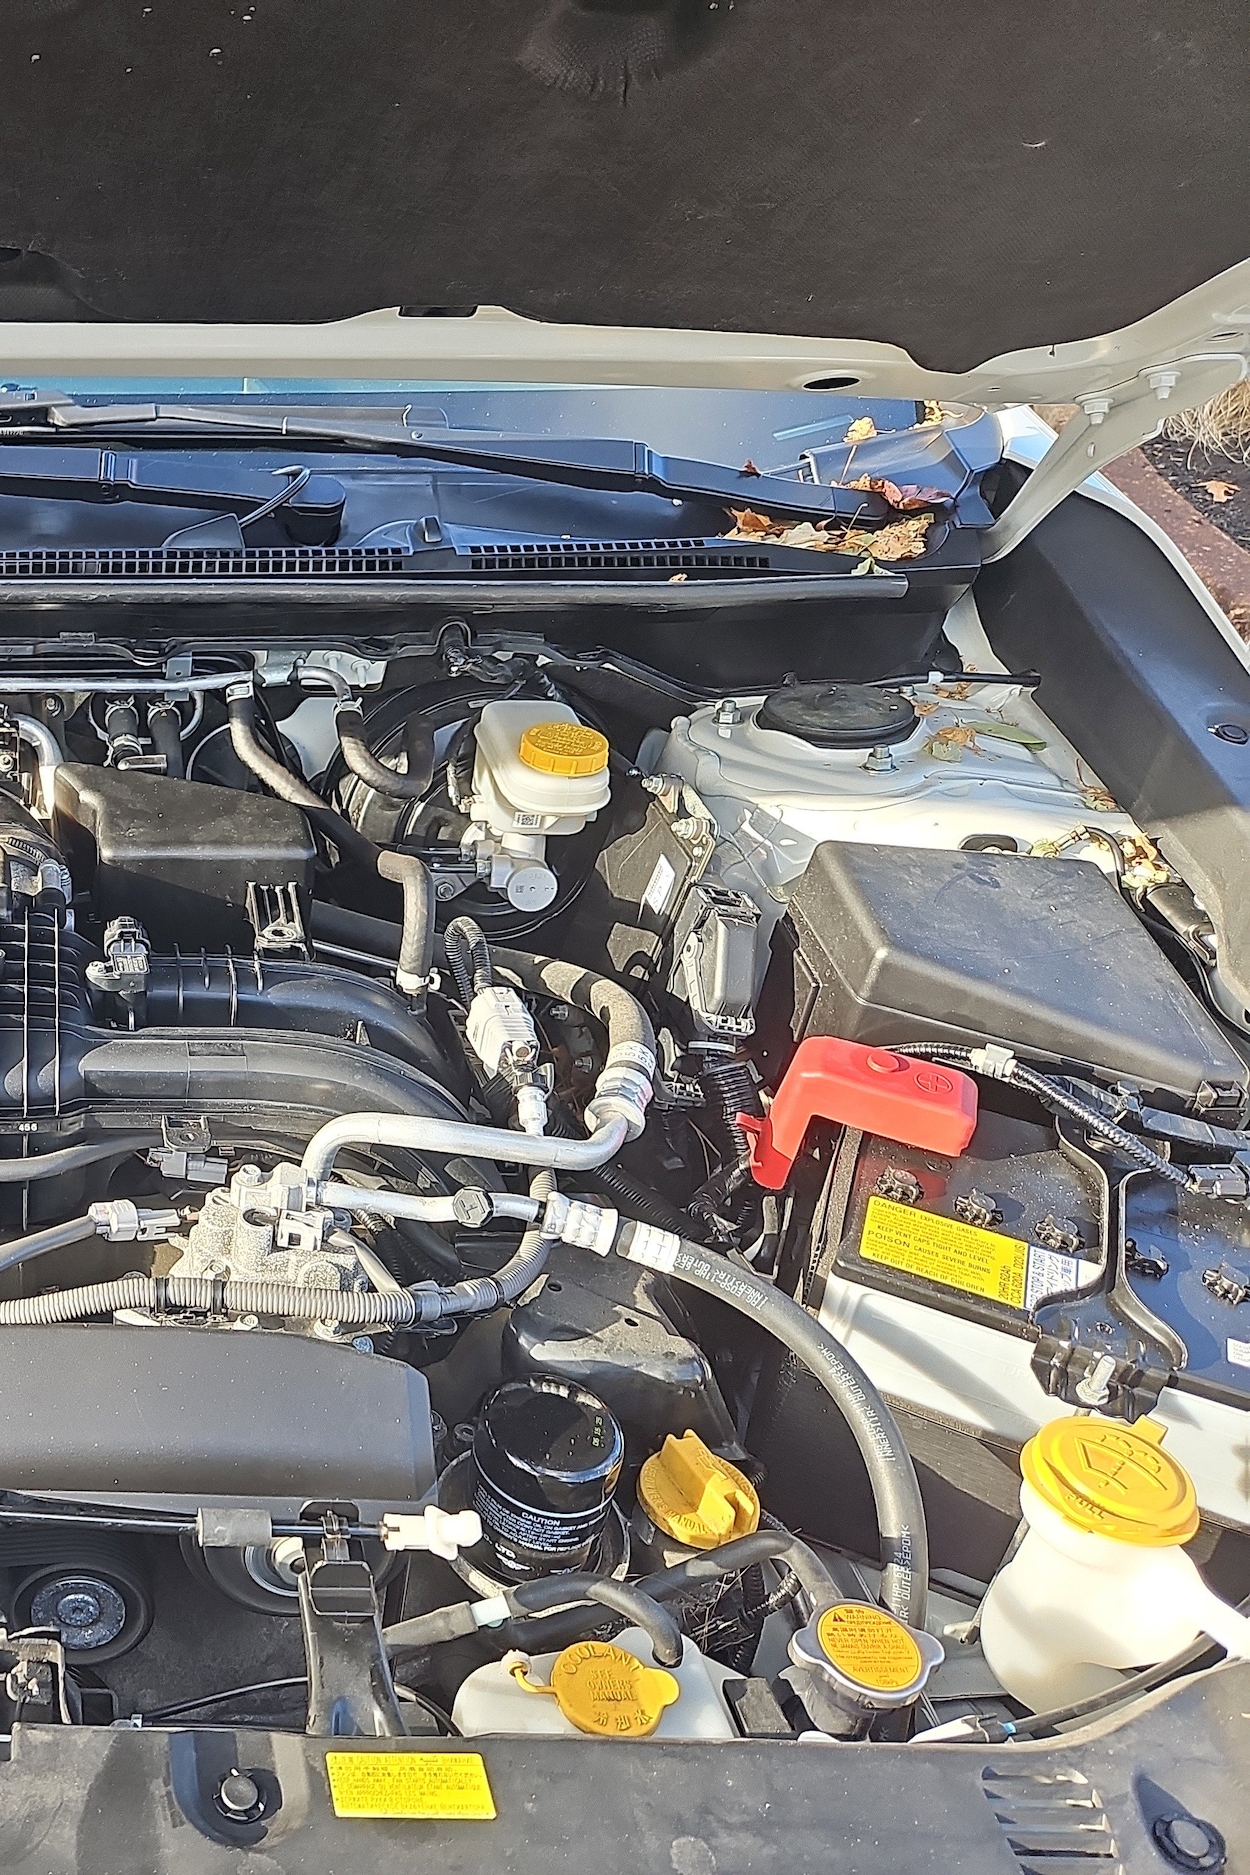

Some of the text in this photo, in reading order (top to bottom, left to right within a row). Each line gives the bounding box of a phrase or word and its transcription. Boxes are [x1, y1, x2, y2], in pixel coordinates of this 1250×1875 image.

[873, 1199, 978, 1236] DANGER EXPLOSIVE GASES
[867, 1229, 990, 1274] POISON CAUSES SEVERE BURNS
[877, 1224, 989, 1264] KEEP VENT CAPS TIGHT AND LEVEL
[1033, 1250, 1046, 1271] START
[872, 1252, 888, 1262] KEEP
[889, 1257, 903, 1266] OUT
[915, 1265, 938, 1278] REACH
[939, 1273, 948, 1281] OF
[950, 1276, 985, 1293] CHILDREN
[1012, 1271, 1023, 1287] 620A
[1010, 1287, 1021, 1304] CCA
[1031, 1276, 1044, 1295] STOP
[521, 1511, 560, 1526] CAUTION
[561, 1643, 644, 1674] COOLANT
[590, 1691, 638, 1701] MANUAL
